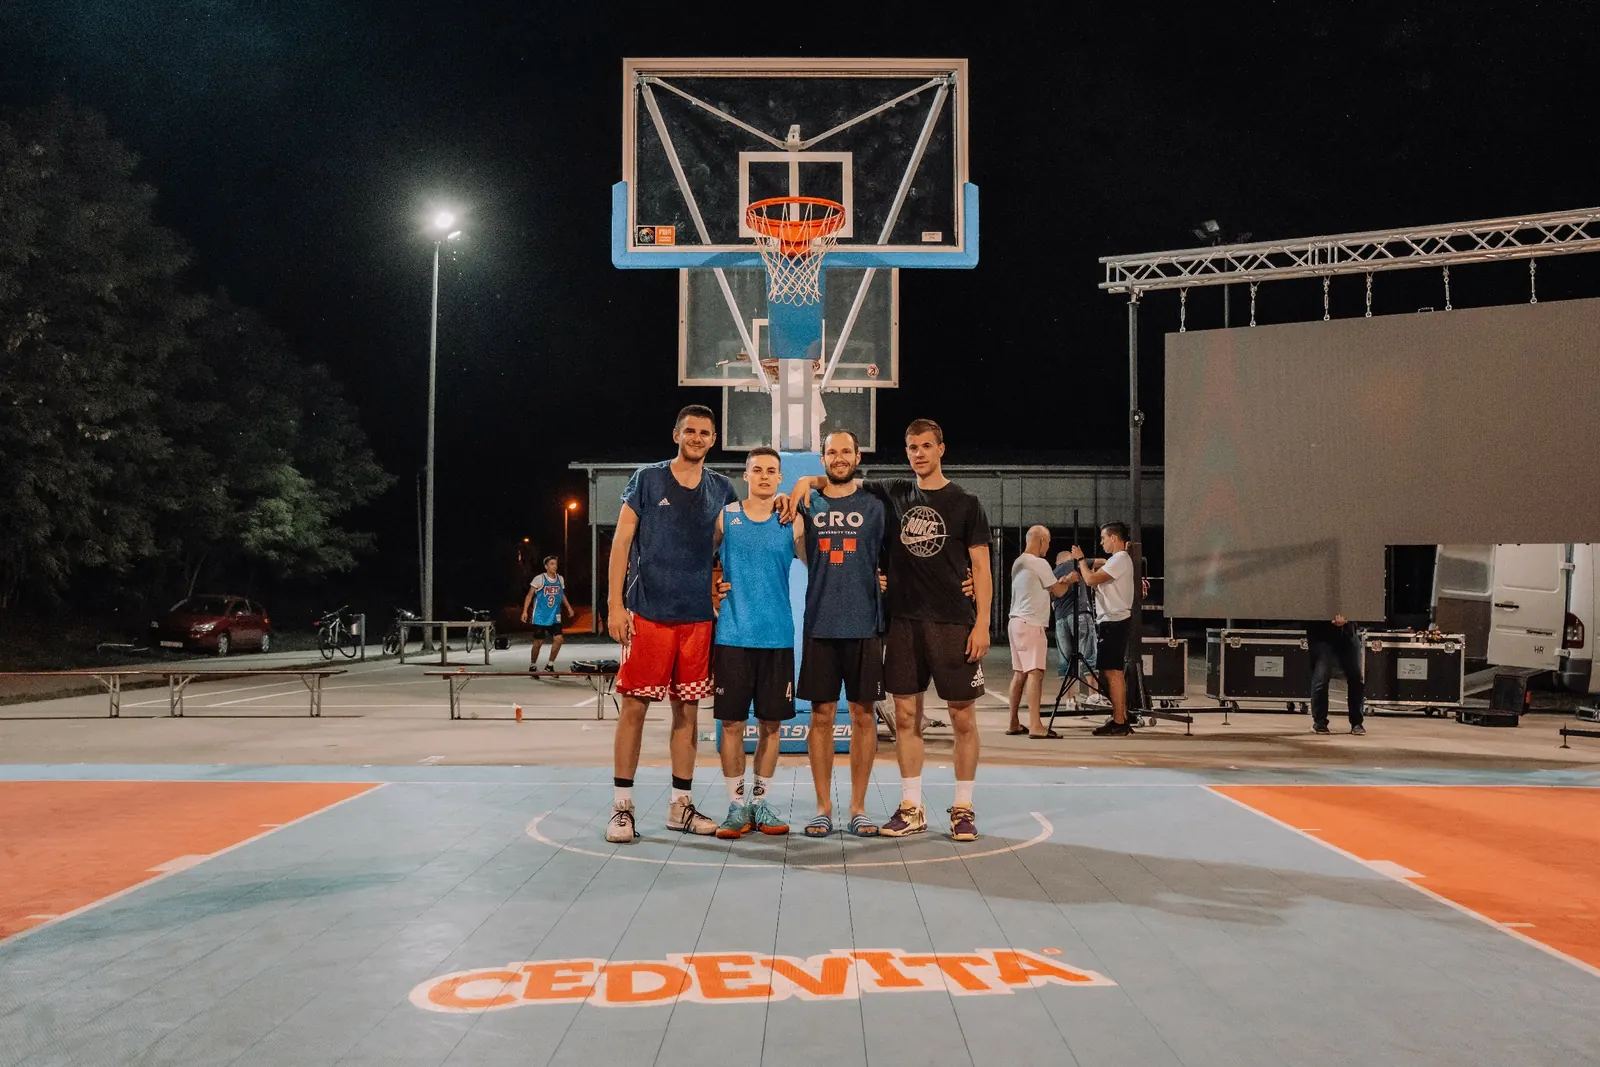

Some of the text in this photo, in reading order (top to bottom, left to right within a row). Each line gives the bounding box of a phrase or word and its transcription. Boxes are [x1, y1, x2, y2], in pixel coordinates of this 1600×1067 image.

[813, 511, 864, 528] CRO
[905, 517, 939, 535] NIKE
[548, 595, 555, 608] 3
[1533, 646, 1544, 654] HR
[785, 681, 792, 702] 4
[426, 950, 1095, 1008] CEDEVITA
